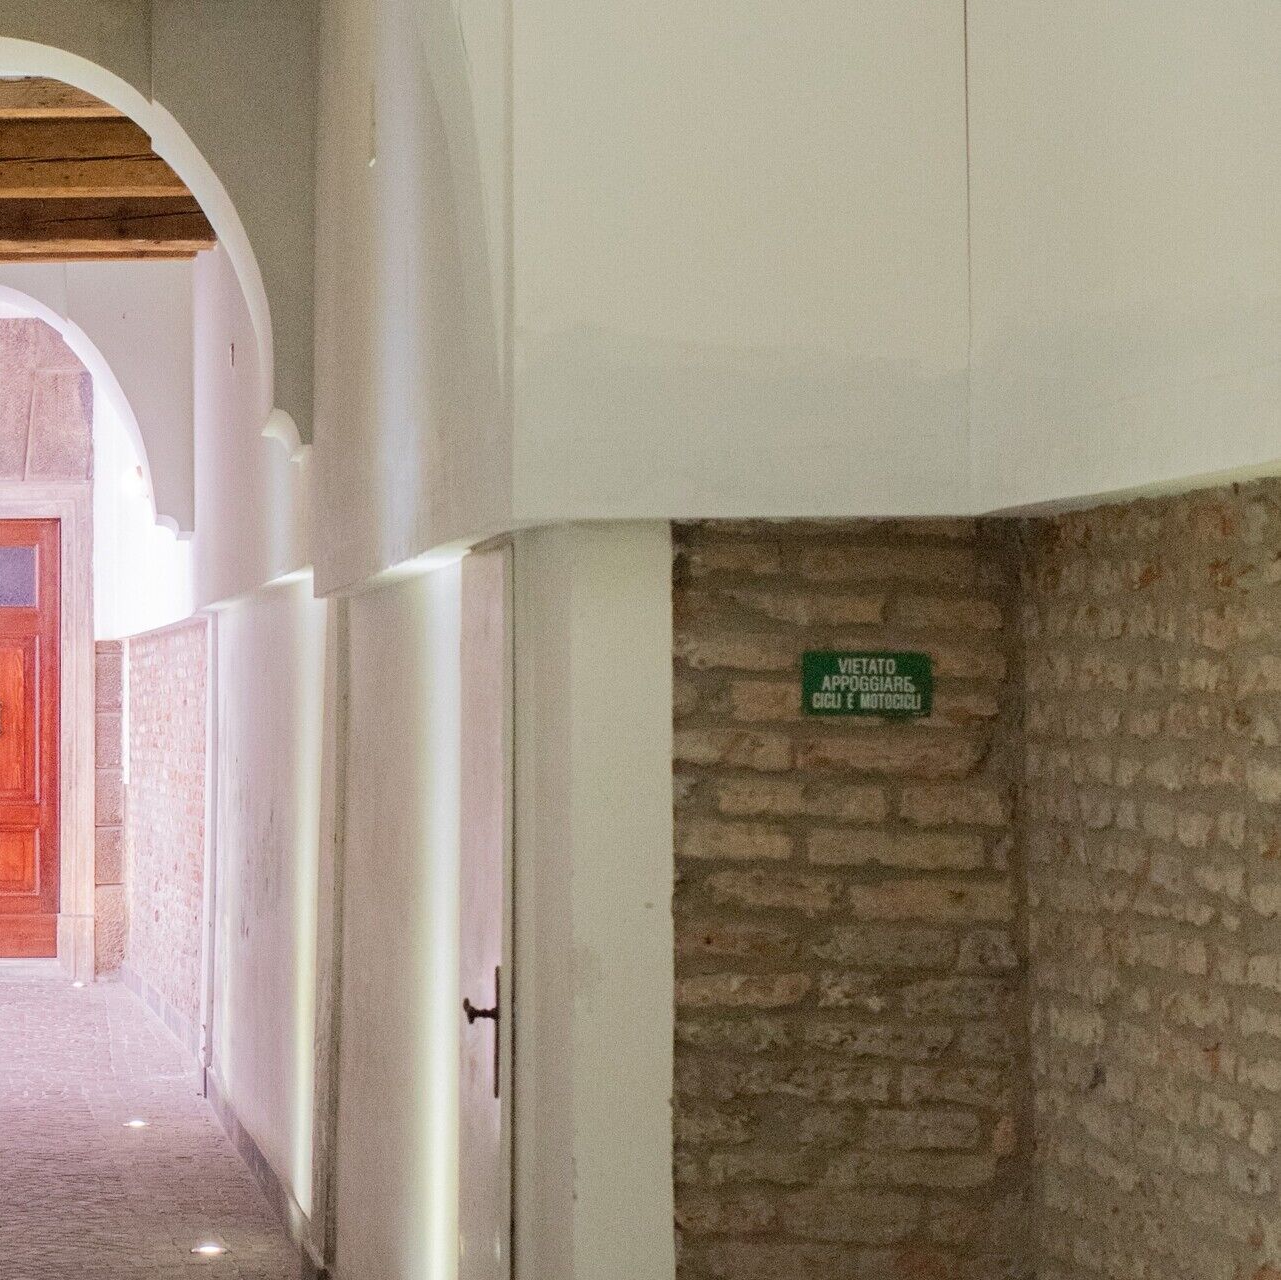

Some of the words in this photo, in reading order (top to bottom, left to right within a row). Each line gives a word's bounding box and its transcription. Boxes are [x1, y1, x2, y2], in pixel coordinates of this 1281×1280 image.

[838, 658, 896, 675] VIETATO
[821, 675, 916, 692] APPOGGIARE
[812, 692, 842, 709] CICLI
[846, 692, 854, 709] E
[860, 693, 921, 709] MOTOCICLI
